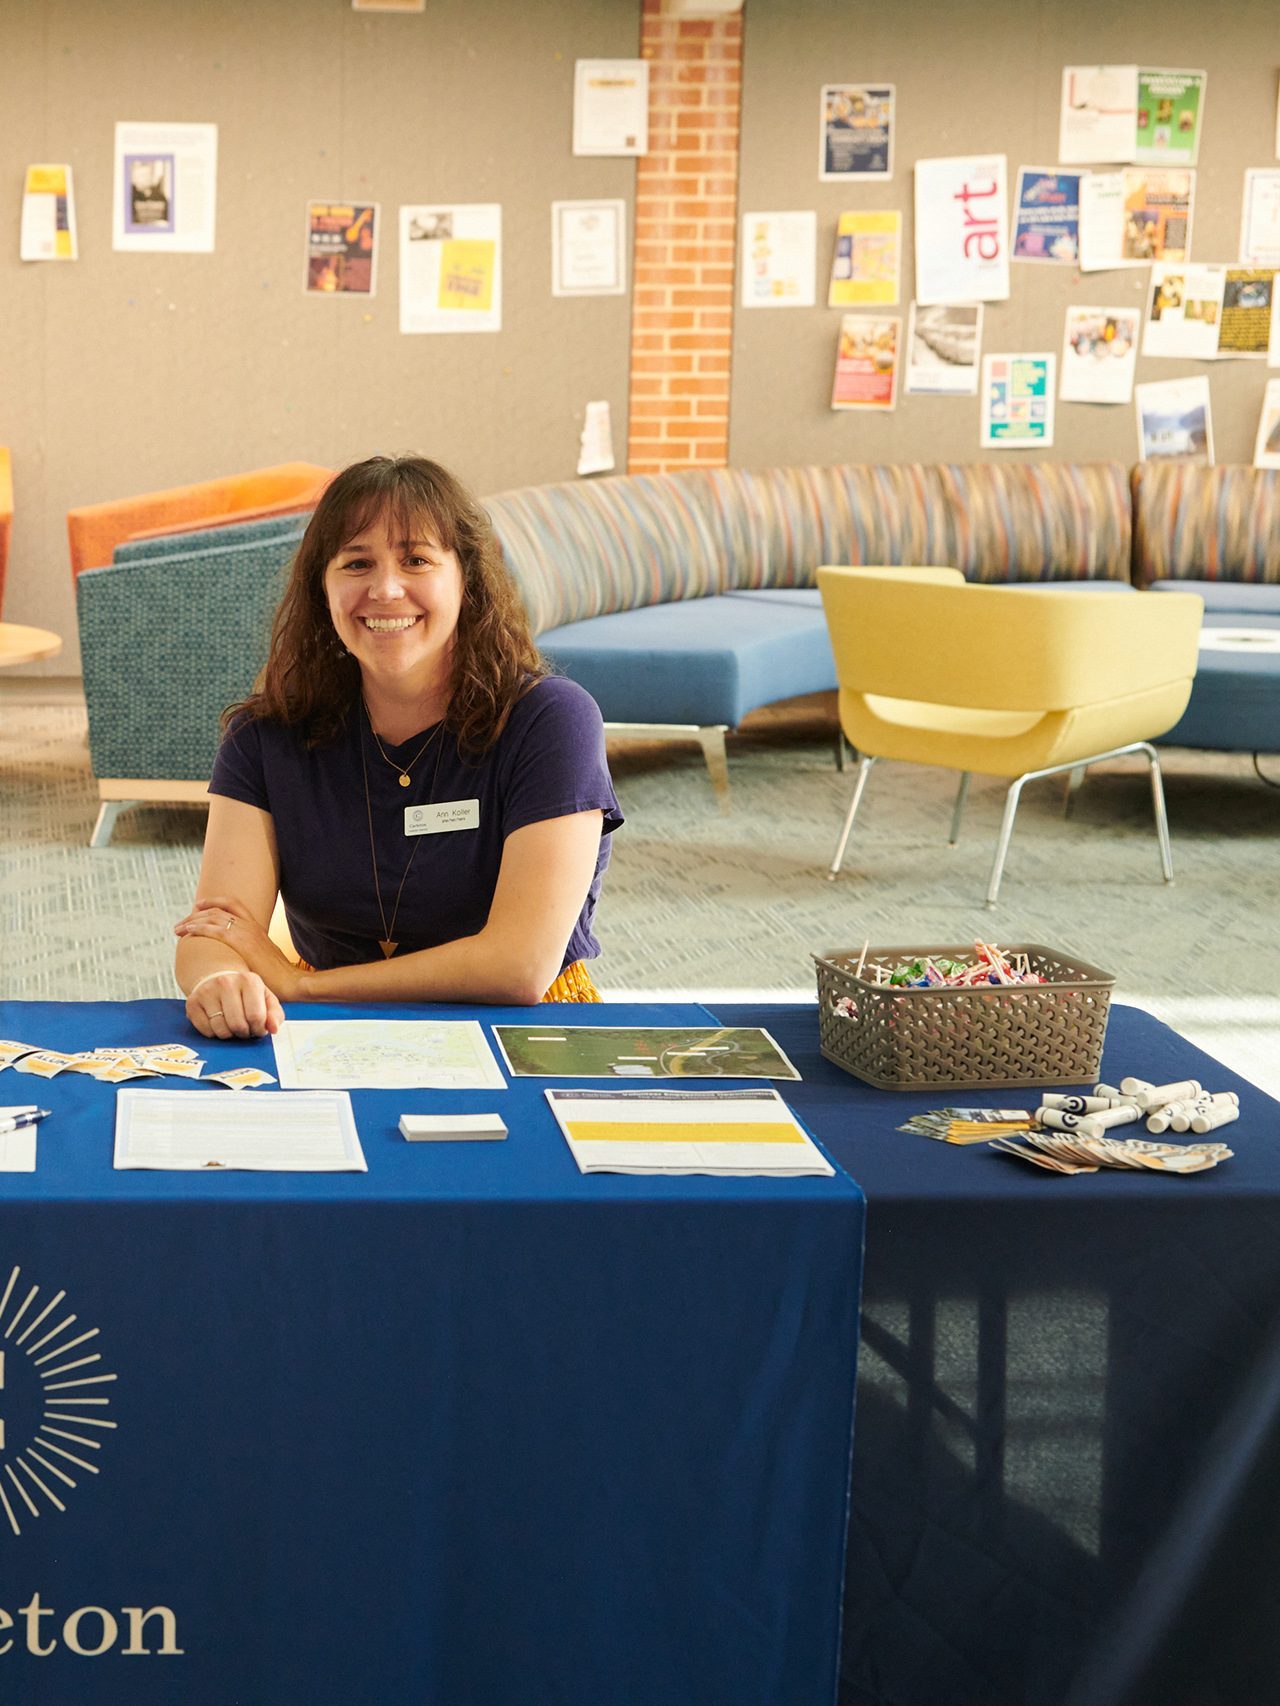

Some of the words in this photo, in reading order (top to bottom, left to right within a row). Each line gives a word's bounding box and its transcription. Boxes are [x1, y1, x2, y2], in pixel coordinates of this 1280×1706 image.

[954, 182, 999, 260] art
[33, 1054, 69, 1066] ALUM
[154, 1057, 198, 1065] ALUM
